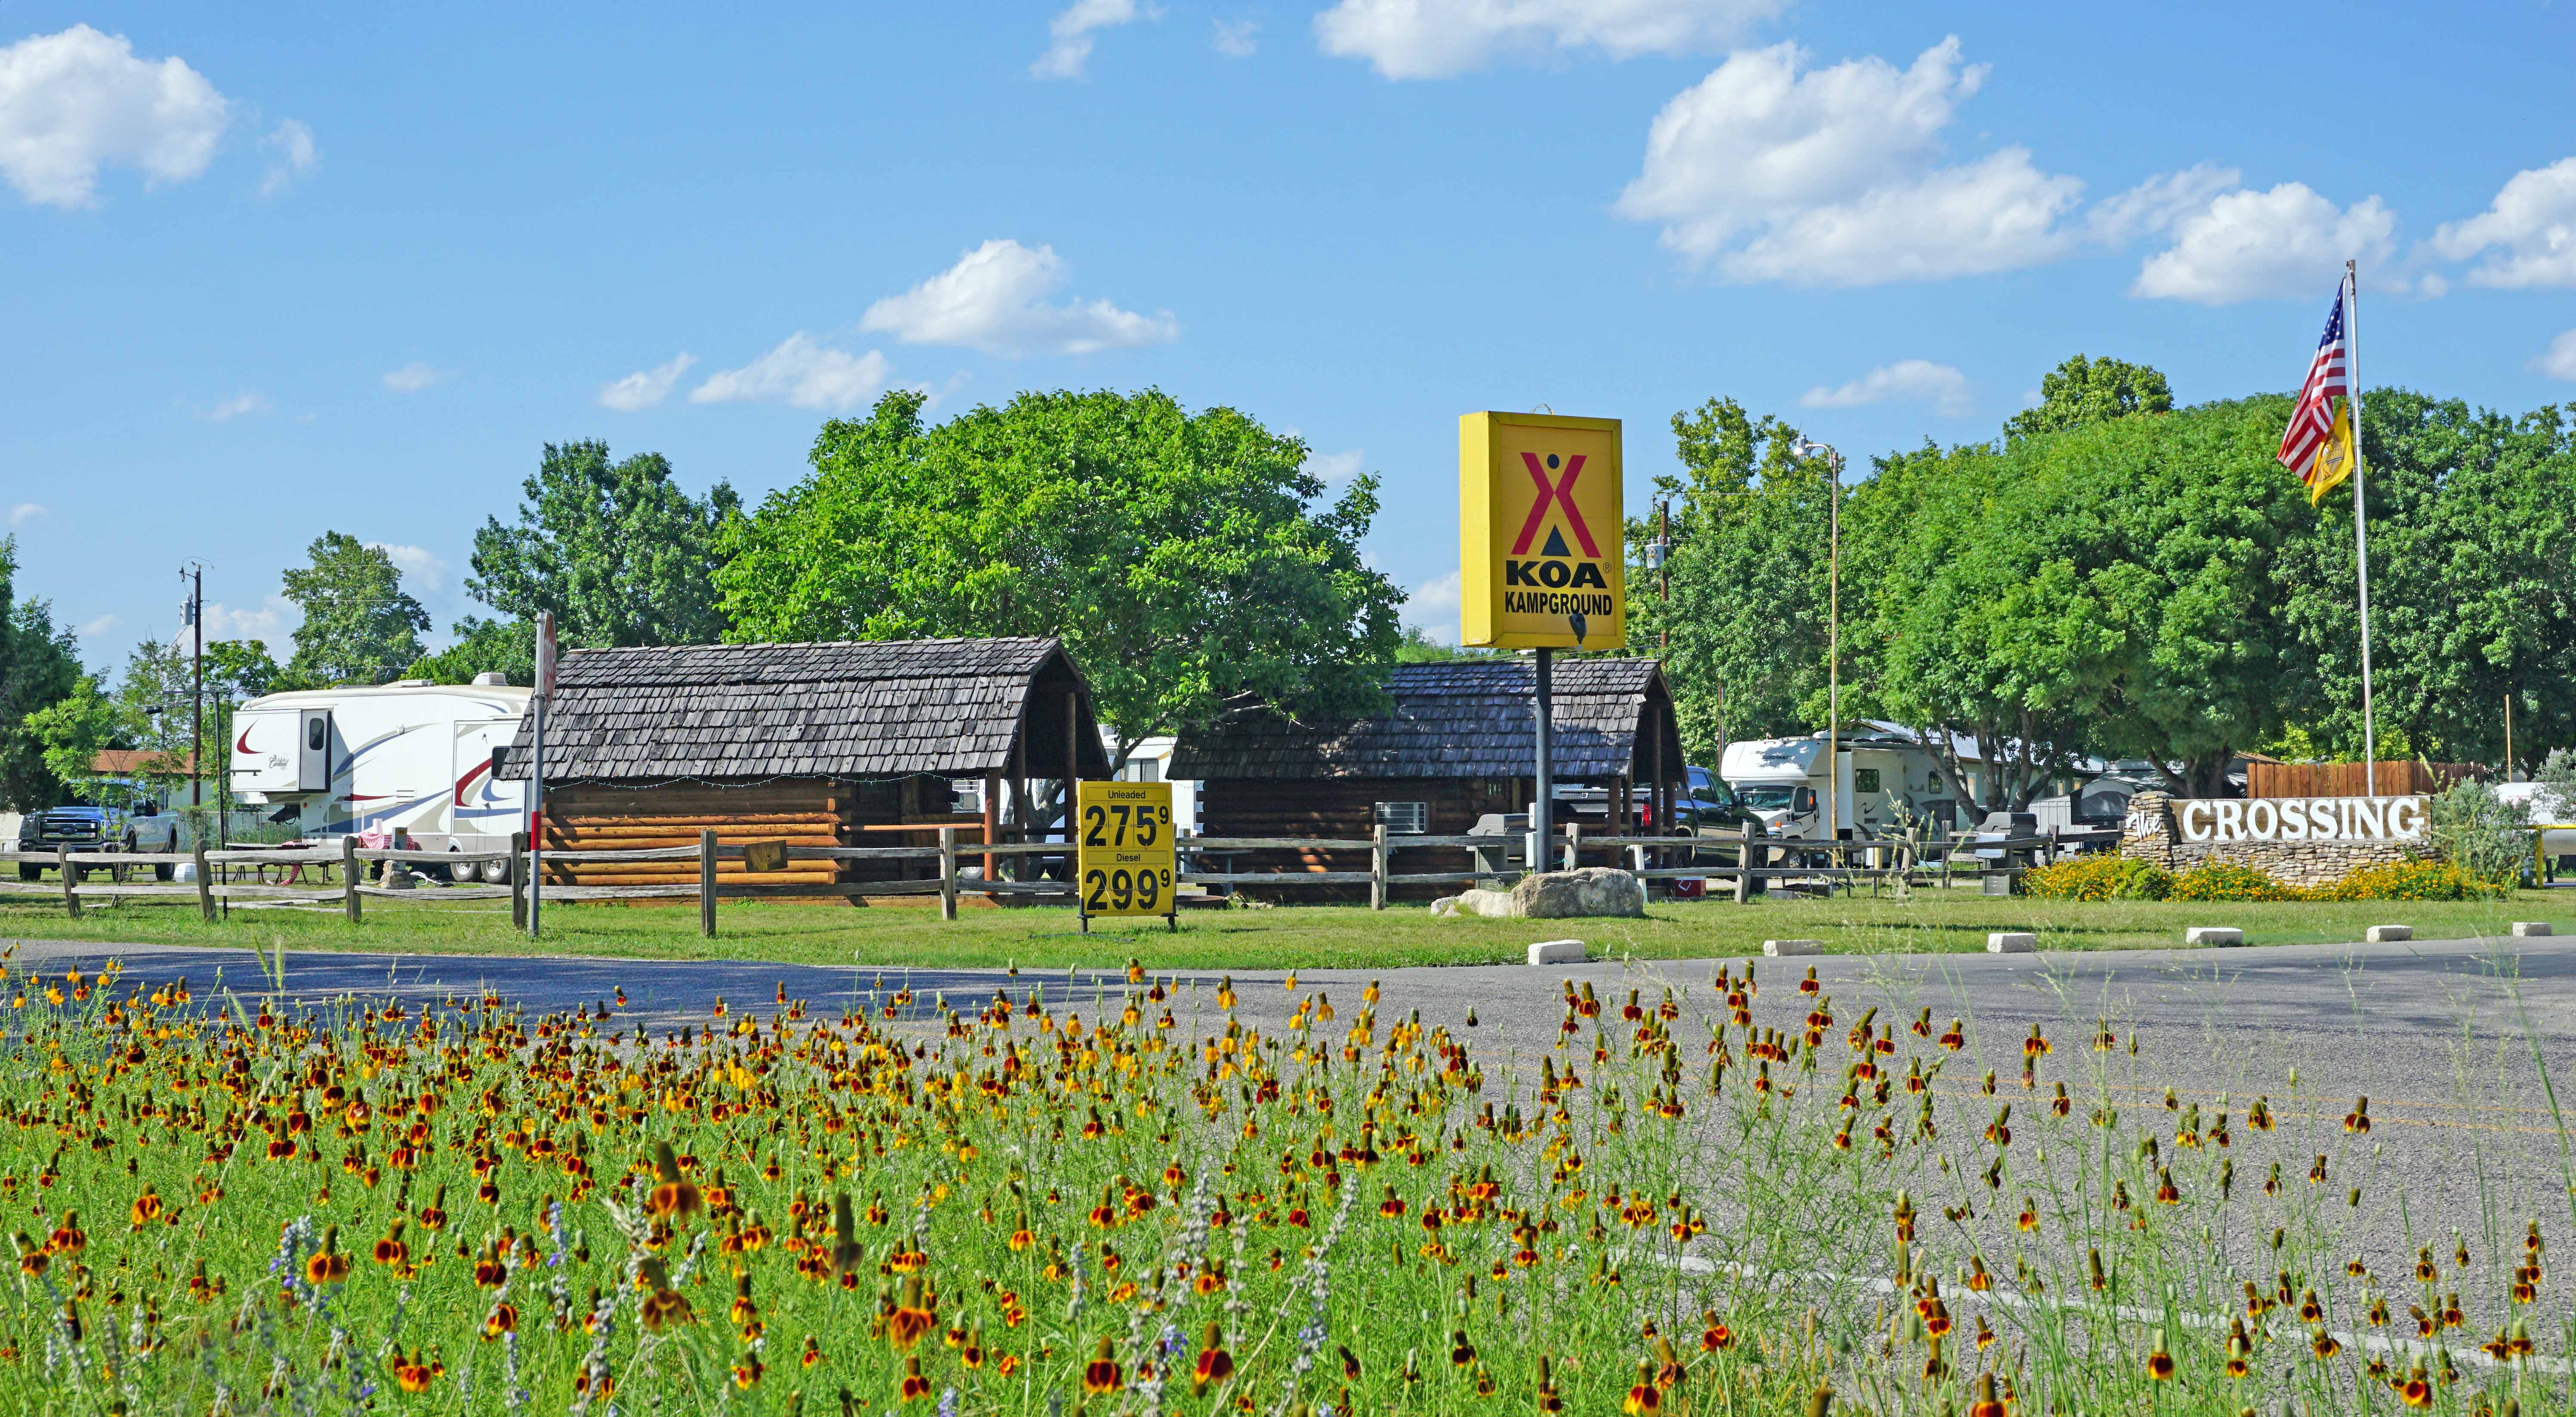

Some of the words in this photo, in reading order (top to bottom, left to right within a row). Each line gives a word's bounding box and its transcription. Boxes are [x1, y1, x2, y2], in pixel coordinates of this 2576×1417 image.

[1506, 560, 1608, 589] KOA
[1505, 591, 1612, 616] KAMPGROUND
[1108, 790, 1146, 799] Unleaded
[2126, 810, 2161, 839] The
[2183, 797, 2425, 841] CROSSING
[1116, 853, 1141, 862] Diesel
